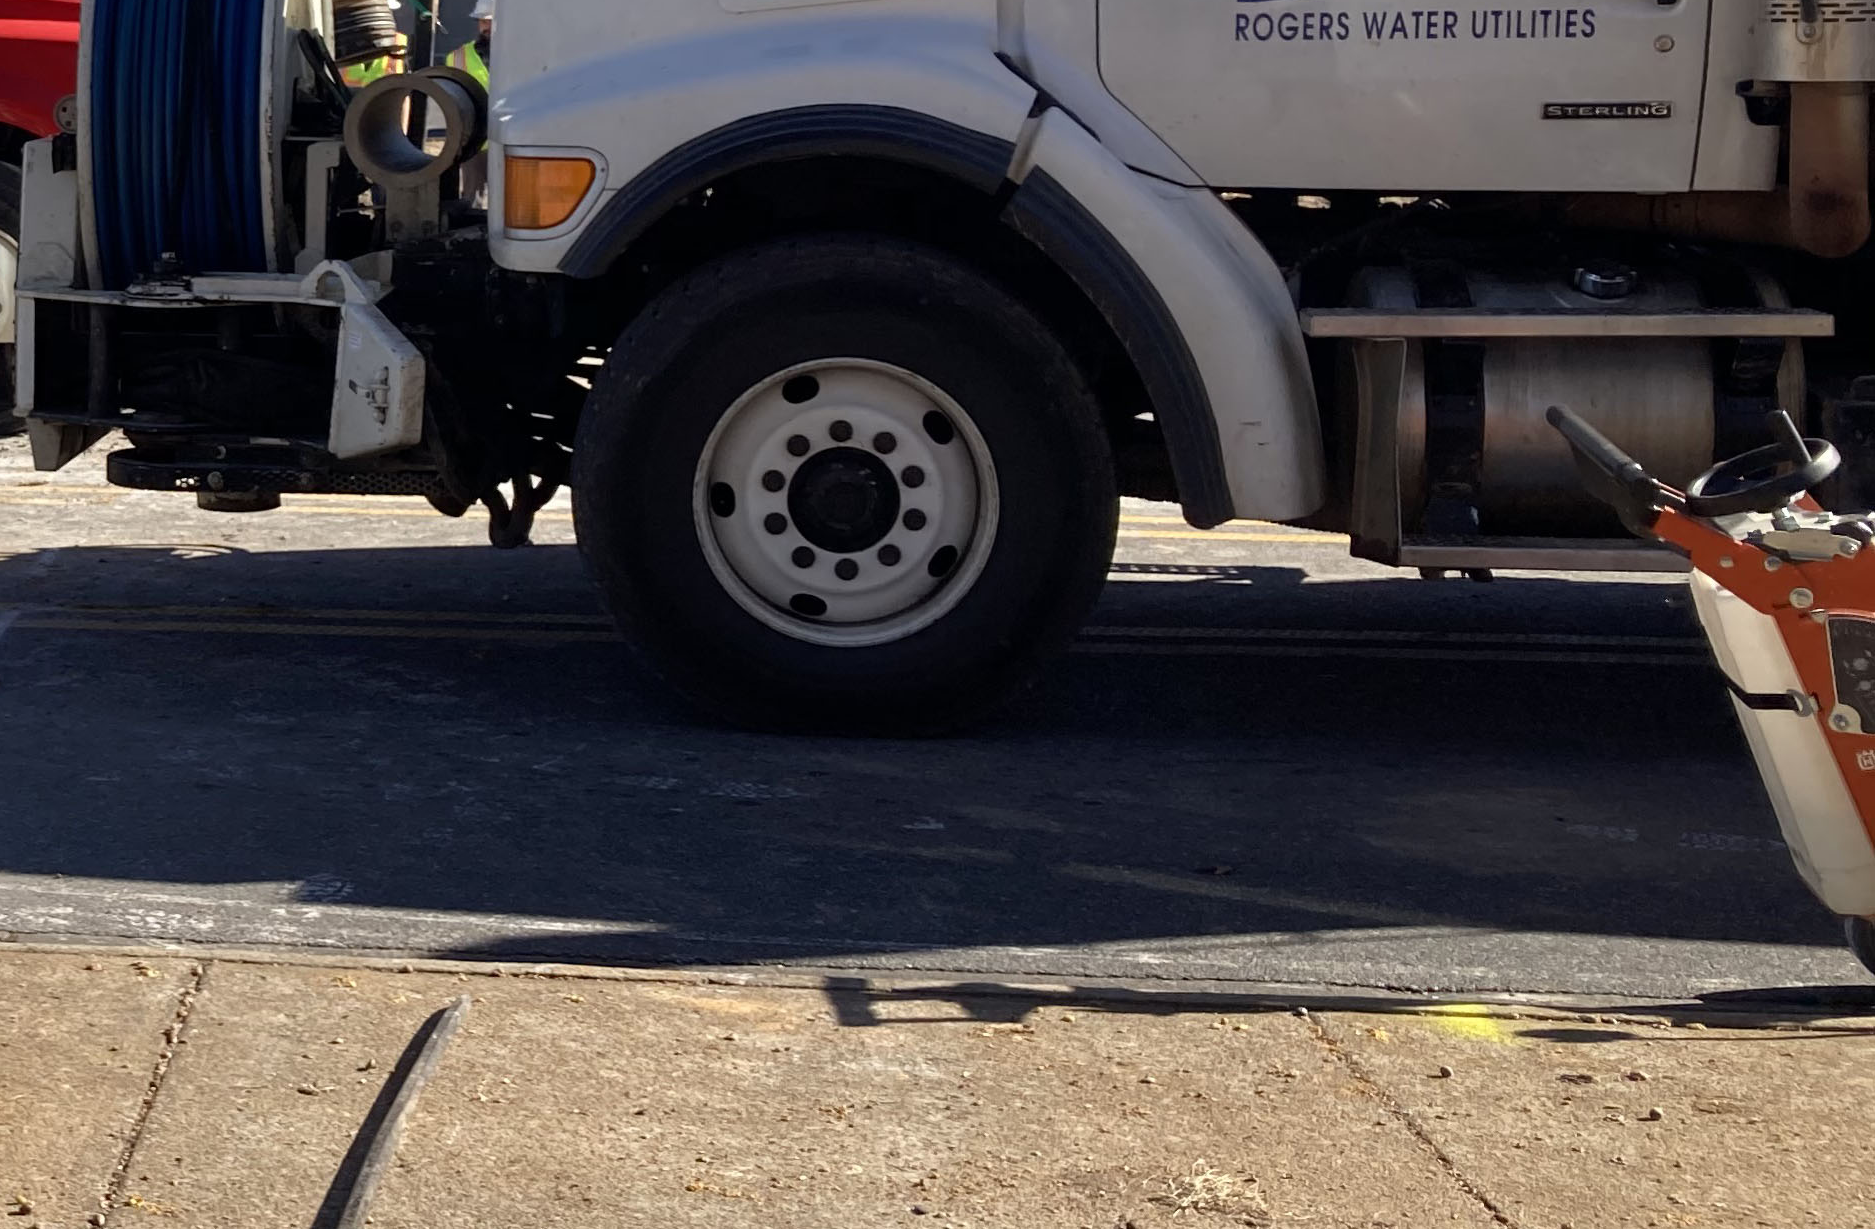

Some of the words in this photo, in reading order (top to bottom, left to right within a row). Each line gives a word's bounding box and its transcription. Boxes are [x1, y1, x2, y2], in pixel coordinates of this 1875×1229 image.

[1235, 12, 1350, 41] ROGERS
[1363, 11, 1458, 39] WATER
[1471, 9, 1596, 38] UTILITIES
[1547, 106, 1668, 116] STERLING
